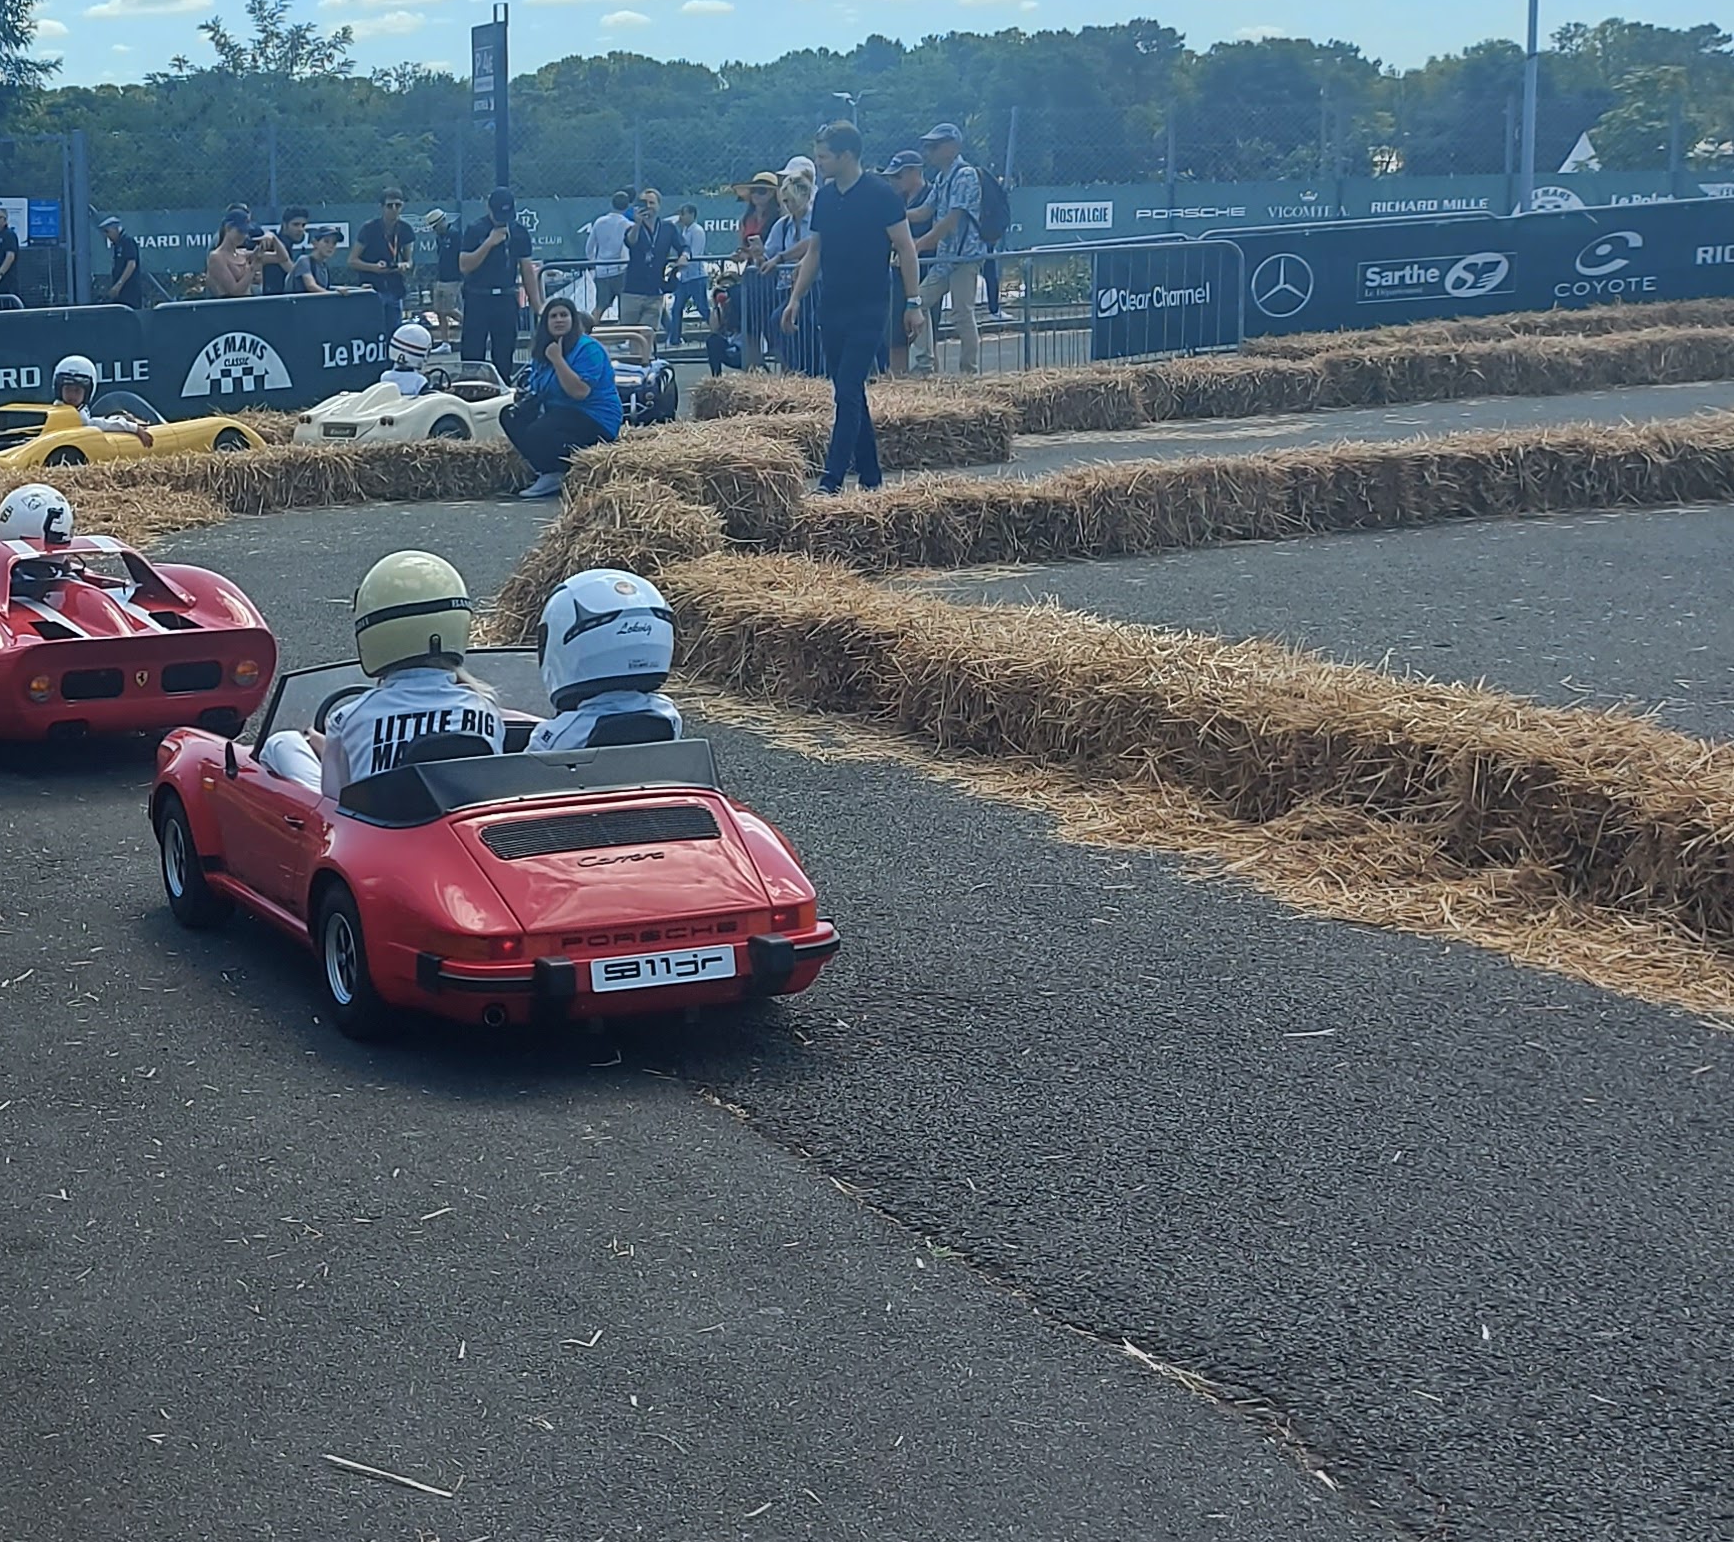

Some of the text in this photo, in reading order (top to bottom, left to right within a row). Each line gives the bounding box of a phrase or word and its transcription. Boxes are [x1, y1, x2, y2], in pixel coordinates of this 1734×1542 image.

[1050, 206, 1109, 225] NOSTALGIE
[1135, 207, 1247, 220] PORSCHE
[1370, 198, 1490, 214] RICHARD MILLE
[704, 219, 740, 232] RICH
[1365, 263, 1441, 288] Sarthe
[1554, 276, 1658, 297] COYOTE
[1118, 281, 1211, 313] Clear Channel
[205, 335, 268, 366] LE MANS
[223, 356, 250, 368] CLASSIC
[322, 333, 387, 368] Le Poi
[95, 359, 150, 384] LLE
[373, 709, 454, 746] LITTLE
[370, 740, 409, 775] MA
[577, 851, 665, 868] Carrera
[561, 920, 738, 949] PORSCHE
